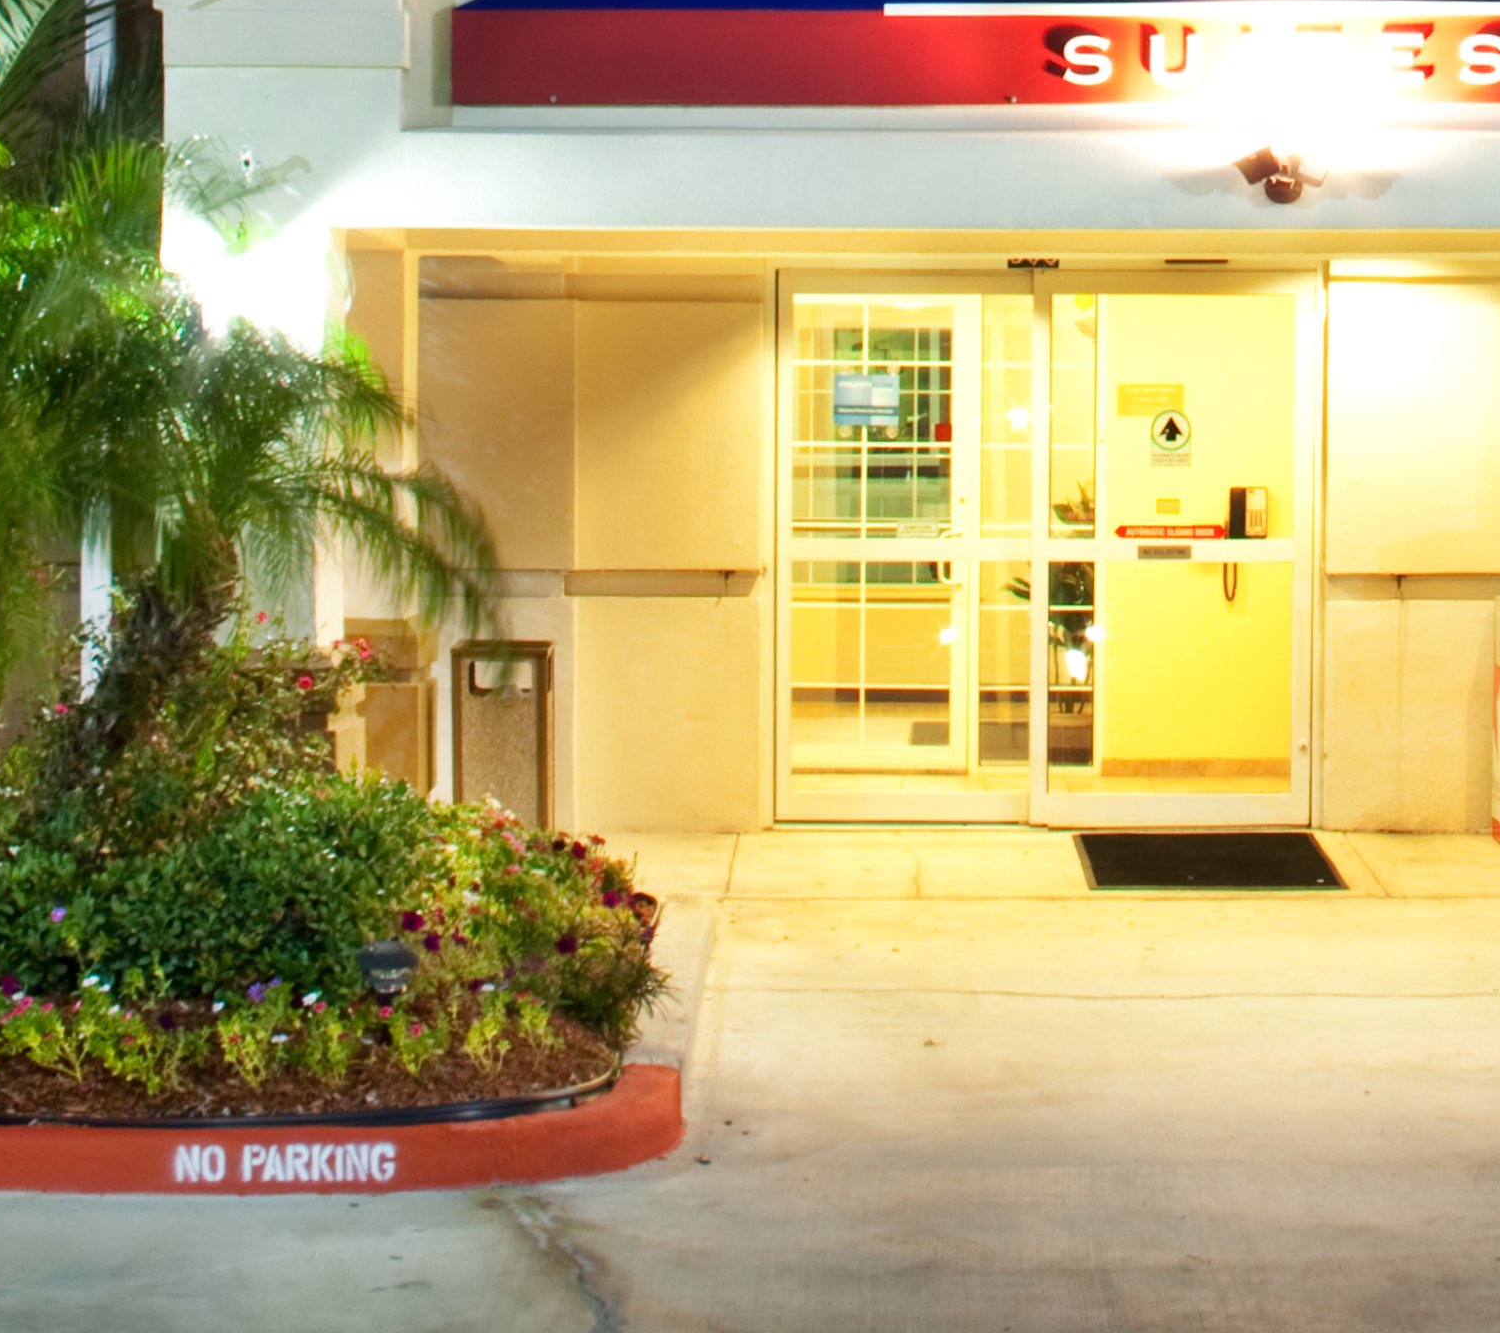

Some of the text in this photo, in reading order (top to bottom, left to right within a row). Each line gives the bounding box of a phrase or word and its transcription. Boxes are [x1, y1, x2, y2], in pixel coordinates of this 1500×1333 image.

[1125, 527, 1215, 536] AUTOMATIC SLIDING DOOR
[173, 1141, 396, 1183] NO PARKING
